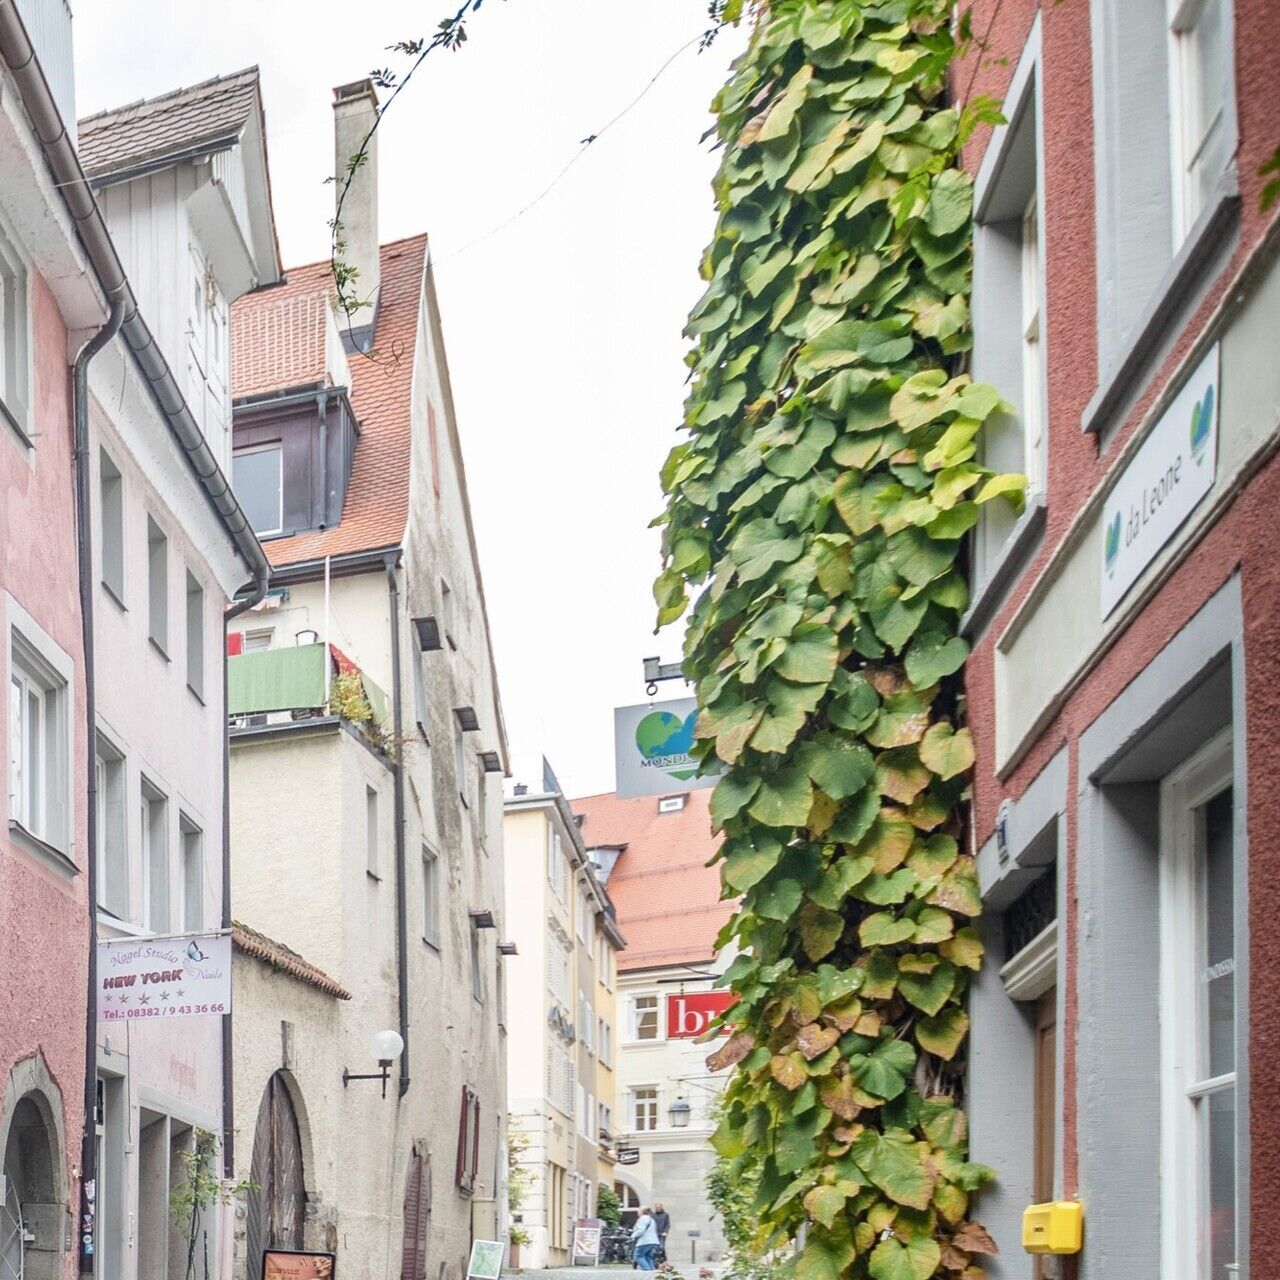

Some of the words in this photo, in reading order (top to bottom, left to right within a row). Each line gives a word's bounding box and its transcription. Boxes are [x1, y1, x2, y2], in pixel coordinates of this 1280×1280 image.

[1126, 504, 1140, 548] da
[1142, 455, 1182, 526] Leone
[141, 969, 183, 985] YORK
[104, 1010, 124, 1019] Tel.:
[127, 1008, 160, 1017] 08382
[169, 1006, 176, 1015] 9
[179, 1005, 191, 1014] 43
[195, 1004, 208, 1013] 36
[211, 1003, 224, 1012] 66
